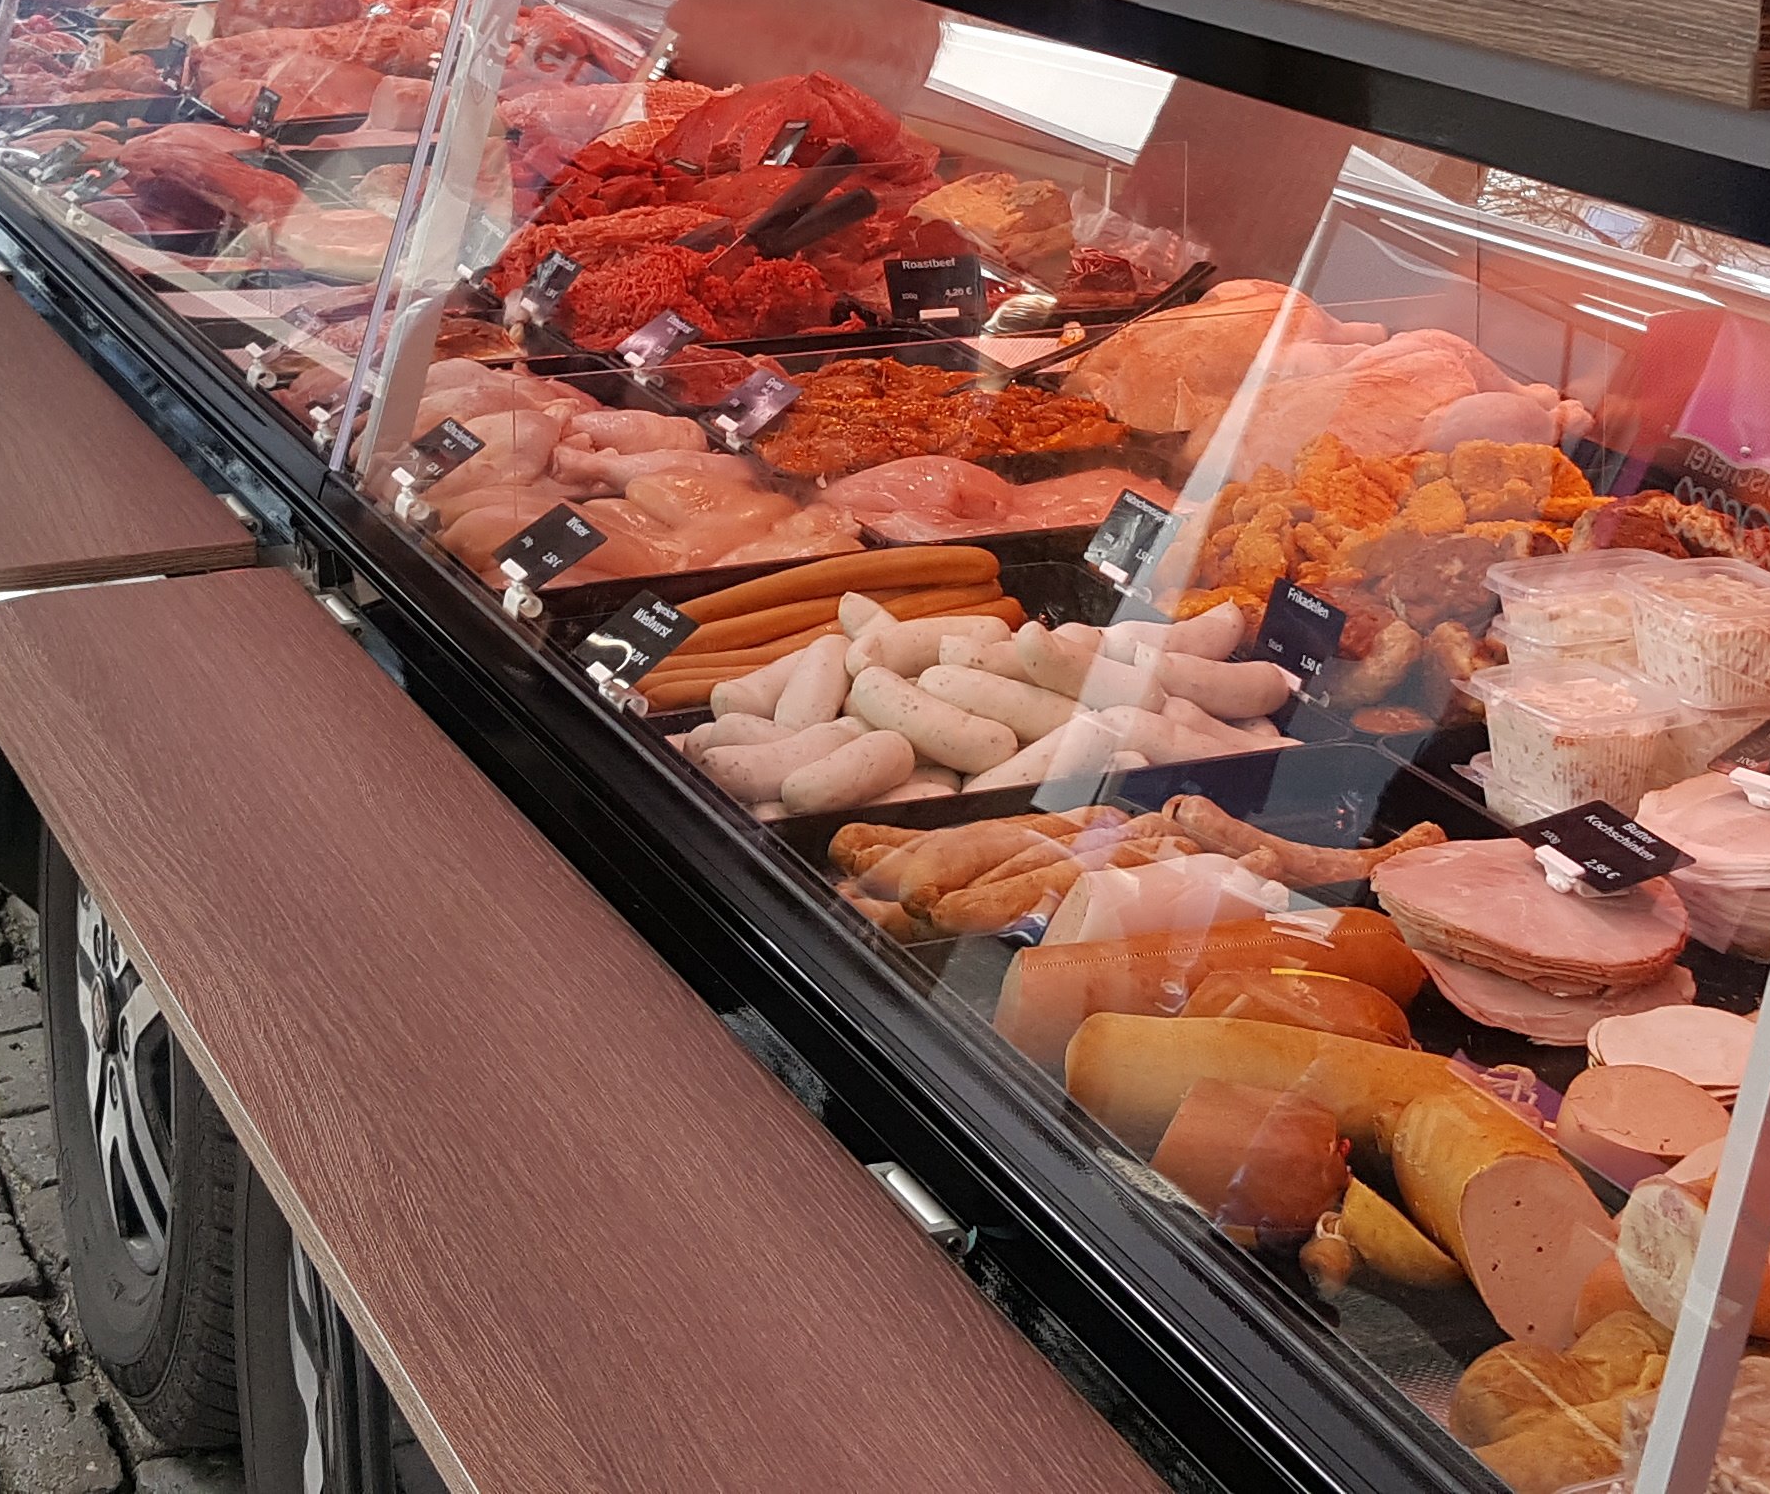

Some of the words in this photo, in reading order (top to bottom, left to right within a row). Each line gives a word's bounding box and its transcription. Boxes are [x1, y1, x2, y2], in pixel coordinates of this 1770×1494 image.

[901, 258, 956, 270] Roastbeef
[1287, 587, 1329, 619] Frikadellen
[1584, 813, 1656, 862] Kochschinken
[1621, 820, 1657, 845] Butter
[1540, 829, 1561, 845] 100g
[1582, 857, 1609, 878] 2,95
[1606, 870, 1621, 881] €
